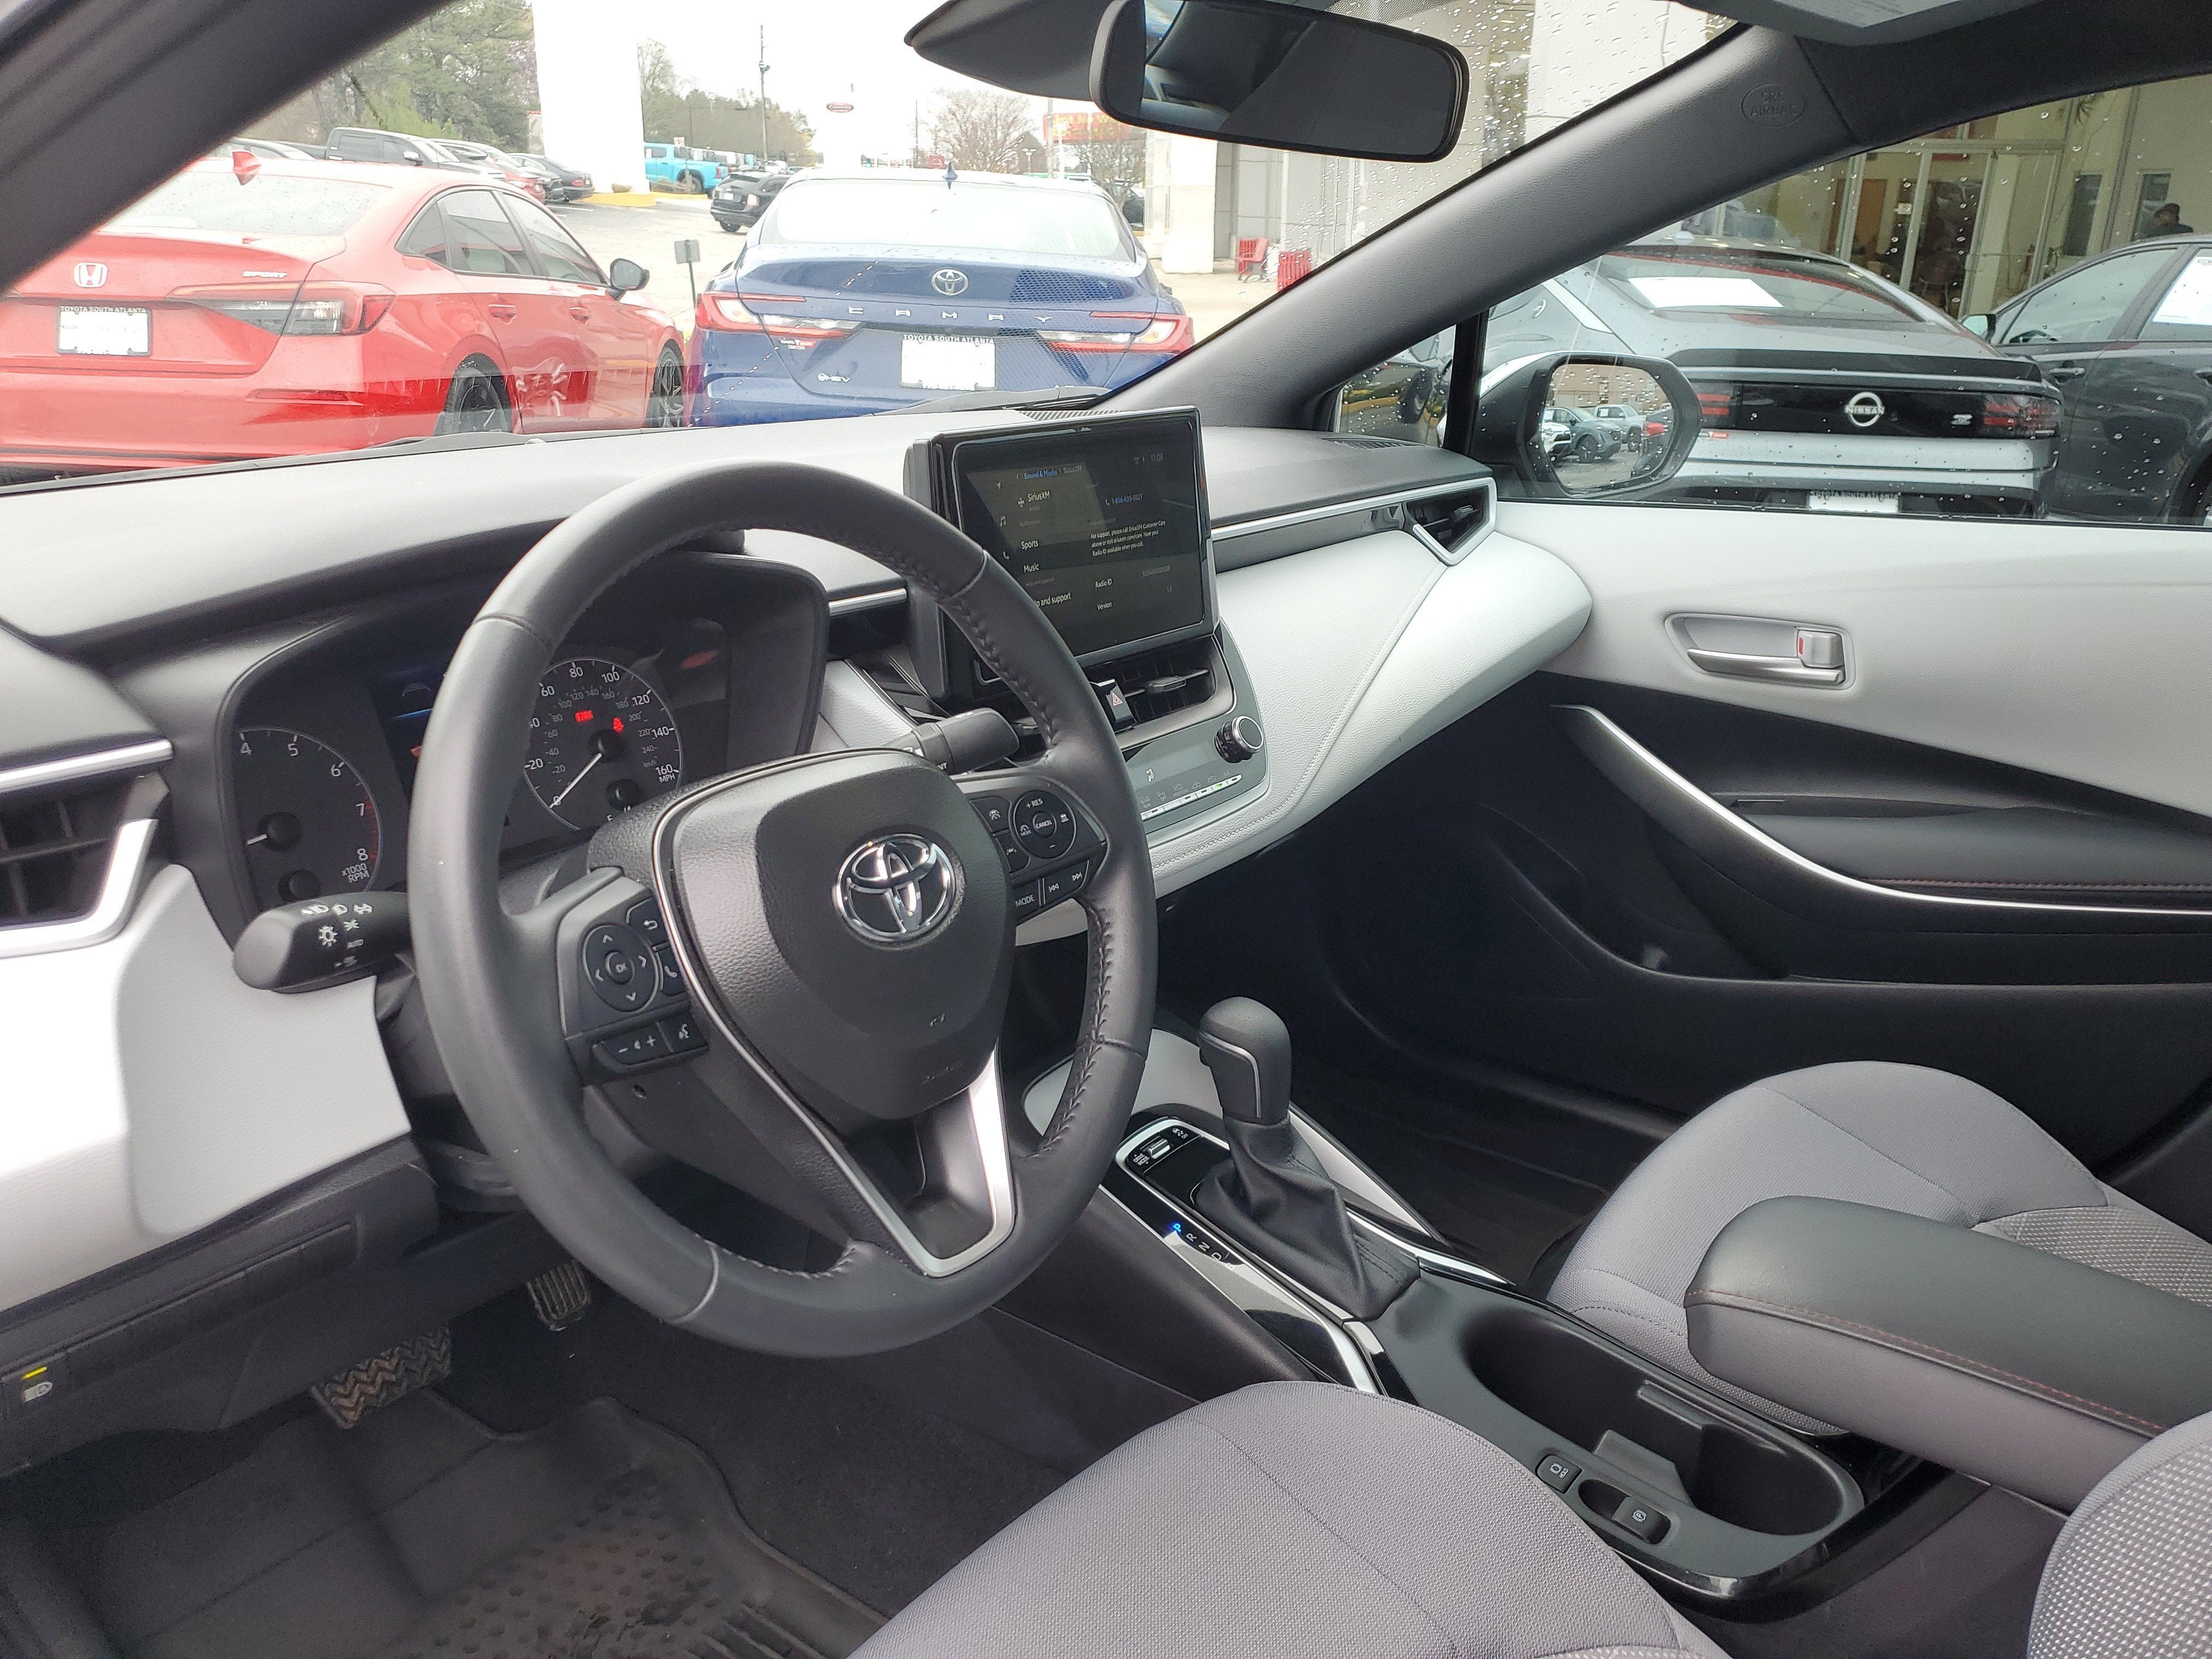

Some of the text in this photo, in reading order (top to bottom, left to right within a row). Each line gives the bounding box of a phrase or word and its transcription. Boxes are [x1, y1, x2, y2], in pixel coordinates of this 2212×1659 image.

[848, 306, 1053, 323] CAMRY
[1845, 404, 1886, 415] NISSAN
[1028, 490, 1050, 502] SiriusXM
[1021, 540, 1039, 551] Sports
[1024, 563, 1040, 573] Music
[1095, 580, 1107, 589] Radio
[1041, 596, 1051, 606] and
[1051, 592, 1071, 605] support
[1097, 602, 1112, 611] Version
[569, 667, 583, 678] 80
[601, 672, 620, 683] 100
[541, 686, 555, 697] 60
[570, 692, 584, 701] 120
[558, 700, 572, 708] 100
[616, 701, 629, 709] 180
[632, 694, 650, 706] 120
[552, 714, 563, 722] 80
[548, 729, 558, 738] 60
[638, 729, 651, 737] 220
[651, 726, 669, 738] 140
[240, 742, 253, 754] 4
[287, 743, 298, 757] 5
[549, 748, 559, 756] 40
[642, 745, 654, 753] 240
[529, 758, 543, 770] 20
[555, 765, 566, 773] 20
[644, 759, 657, 768] km/h
[330, 764, 341, 777] 6
[655, 764, 673, 776] 160
[659, 772, 676, 783] MPH
[356, 803, 364, 816] 7
[1035, 820, 1053, 829] CANCEL
[357, 848, 369, 861] 8
[341, 863, 367, 876] x1000
[348, 870, 370, 883] RPM
[1015, 894, 1035, 907] MODE
[347, 939, 364, 950] AUTO
[1172, 1223, 1182, 1233] P
[1186, 1233, 1198, 1242] R
[1198, 1242, 1210, 1252] N
[1211, 1251, 1222, 1262] D
